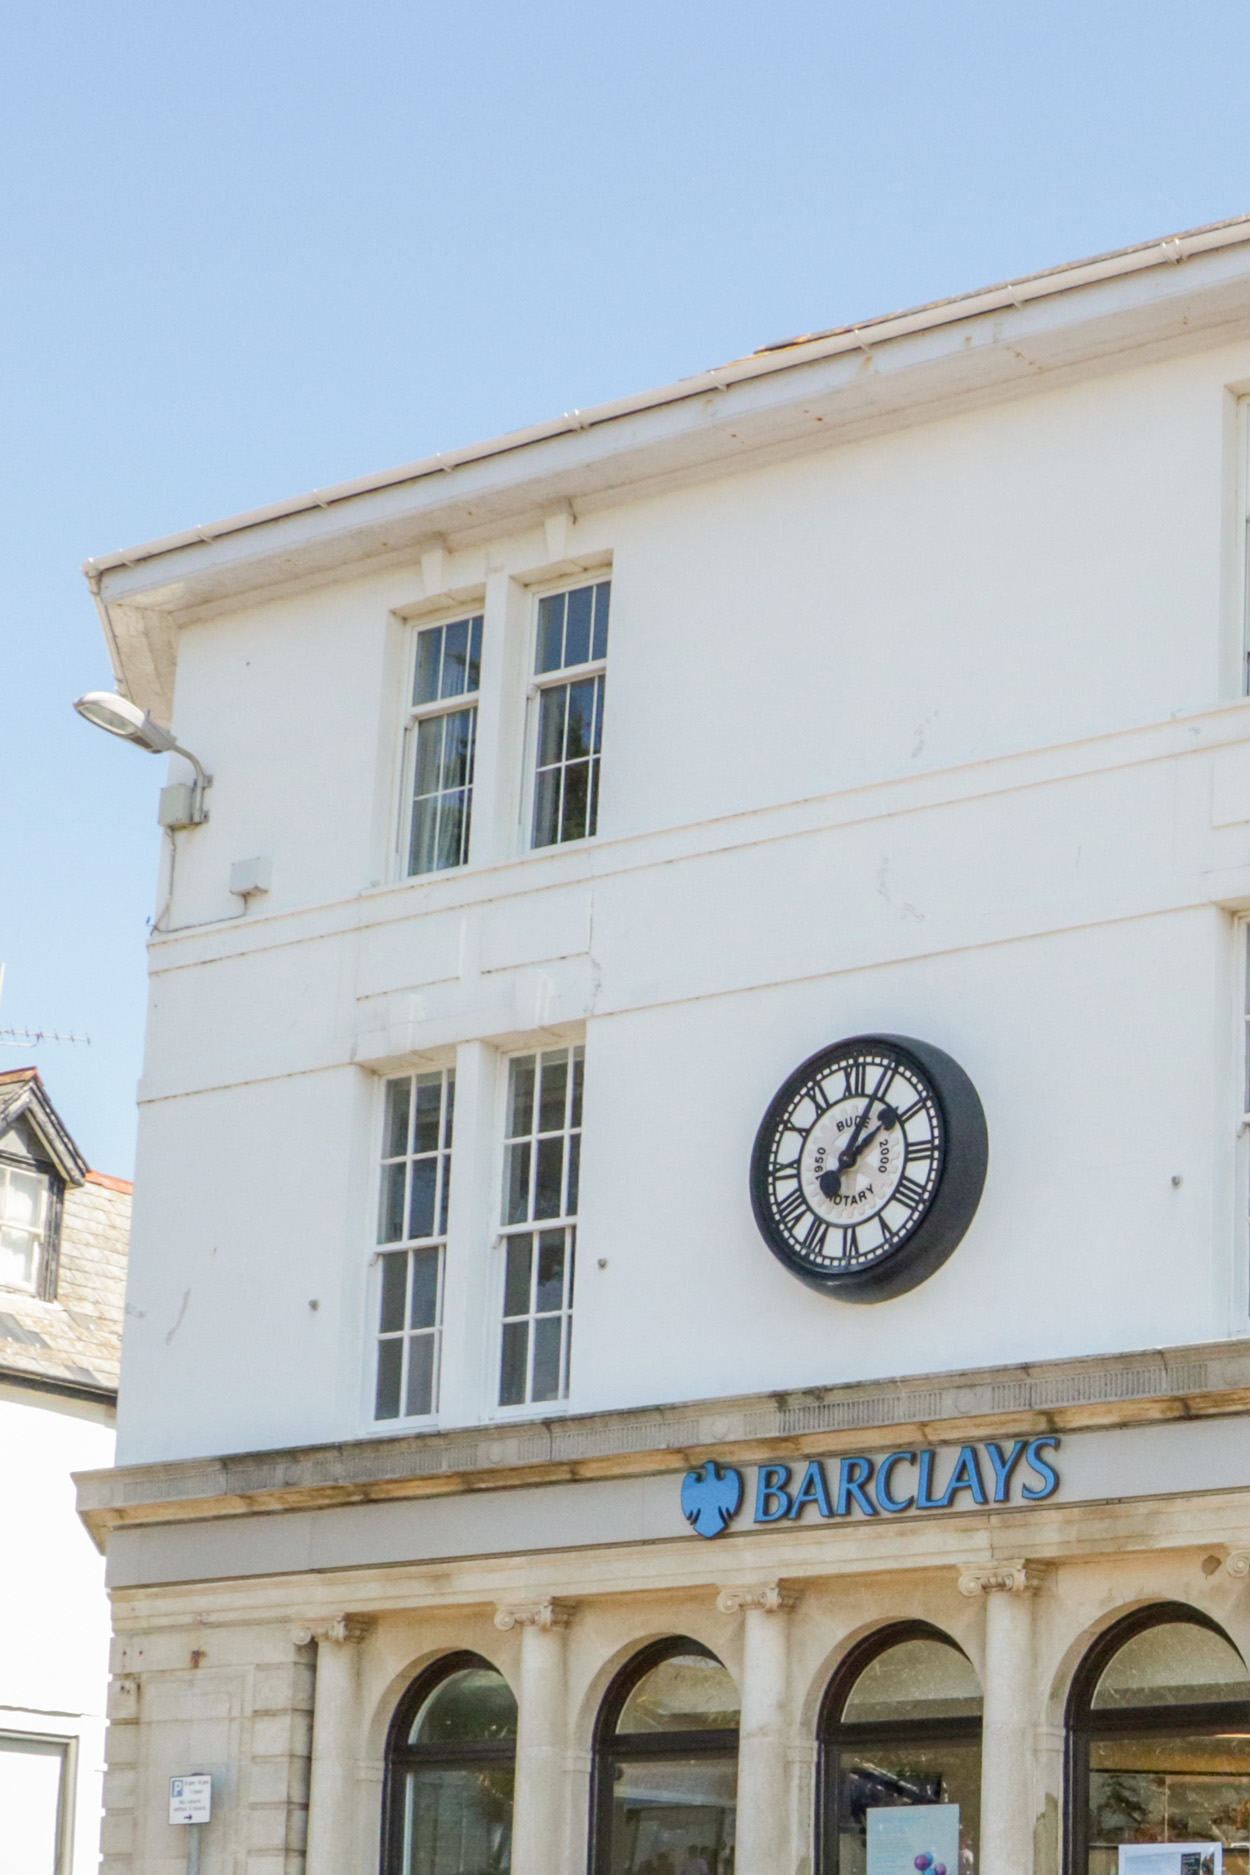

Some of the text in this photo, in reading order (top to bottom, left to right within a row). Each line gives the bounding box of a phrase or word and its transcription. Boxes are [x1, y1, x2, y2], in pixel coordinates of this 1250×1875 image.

[842, 1065, 866, 1096] XII
[806, 1083, 829, 1118] XI
[786, 1120, 810, 1139] X
[878, 1139, 890, 1173] 2000
[906, 1140, 933, 1163] III
[774, 1159, 800, 1181] IX
[829, 1183, 874, 1206] OTARY
[754, 1437, 1061, 1523] BARCLAYS
